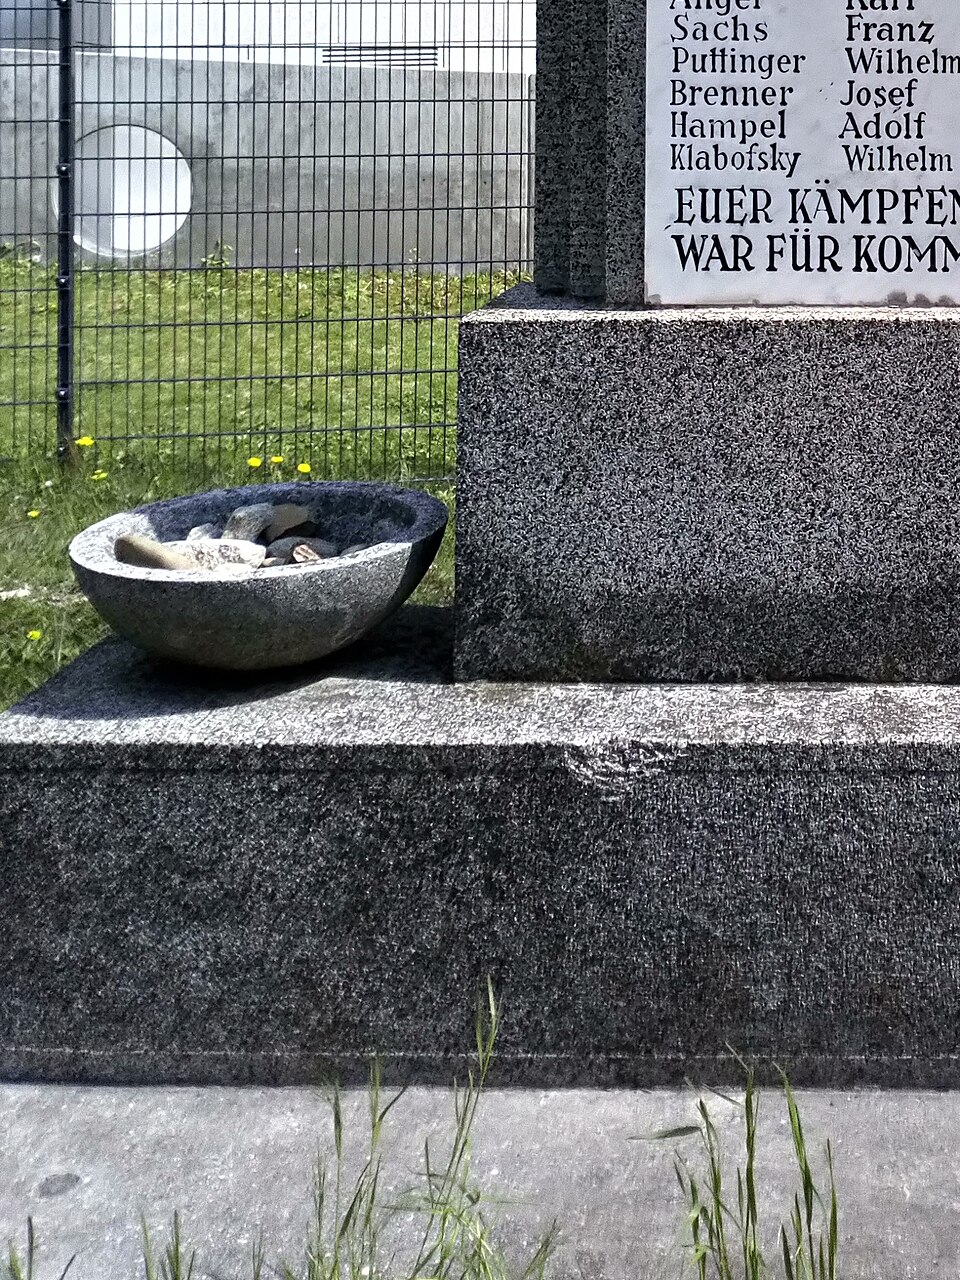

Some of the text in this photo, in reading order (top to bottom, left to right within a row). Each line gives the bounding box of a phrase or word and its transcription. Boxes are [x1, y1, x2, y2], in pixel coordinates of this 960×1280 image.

[670, 14, 935, 45] Sachs Franz
[671, 47, 807, 80] Puttinger
[669, 79, 919, 109] Brenner Josef
[670, 111, 927, 144] Hampel Adolf
[669, 143, 954, 179] Klabofsky Wilhelm
[673, 184, 774, 228] EUER
[670, 233, 756, 273] WAR
[765, 229, 842, 273] FÜR
